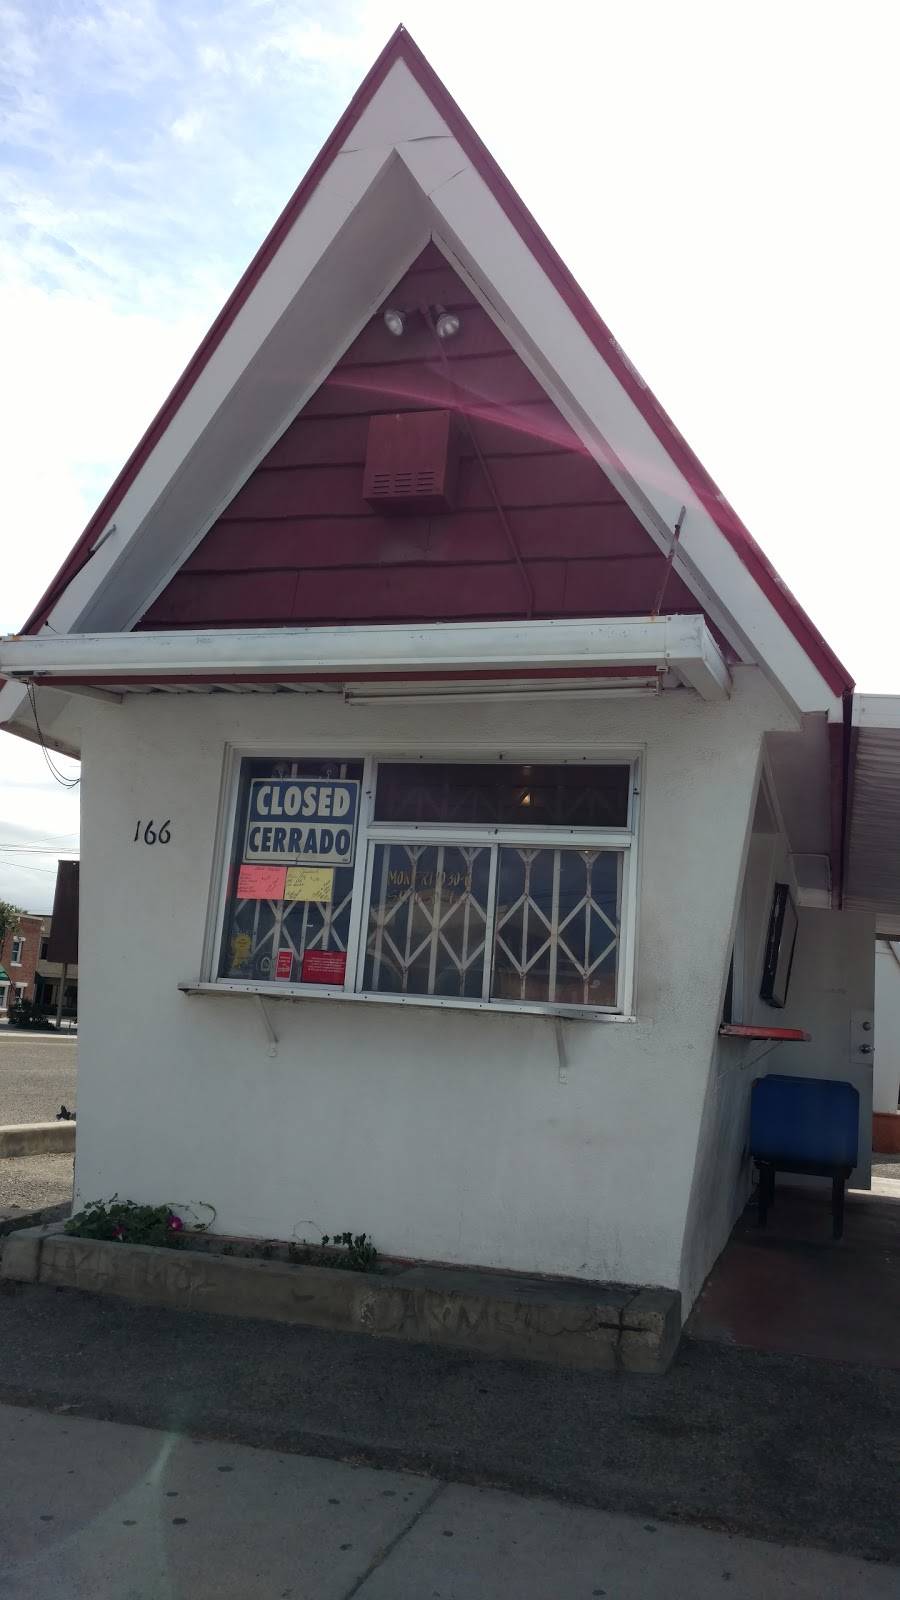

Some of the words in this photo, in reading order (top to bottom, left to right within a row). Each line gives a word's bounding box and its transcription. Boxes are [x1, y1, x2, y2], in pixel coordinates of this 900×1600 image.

[256, 785, 351, 817] CLOSED
[134, 820, 171, 845] 166
[248, 826, 351, 856] CERRADO
